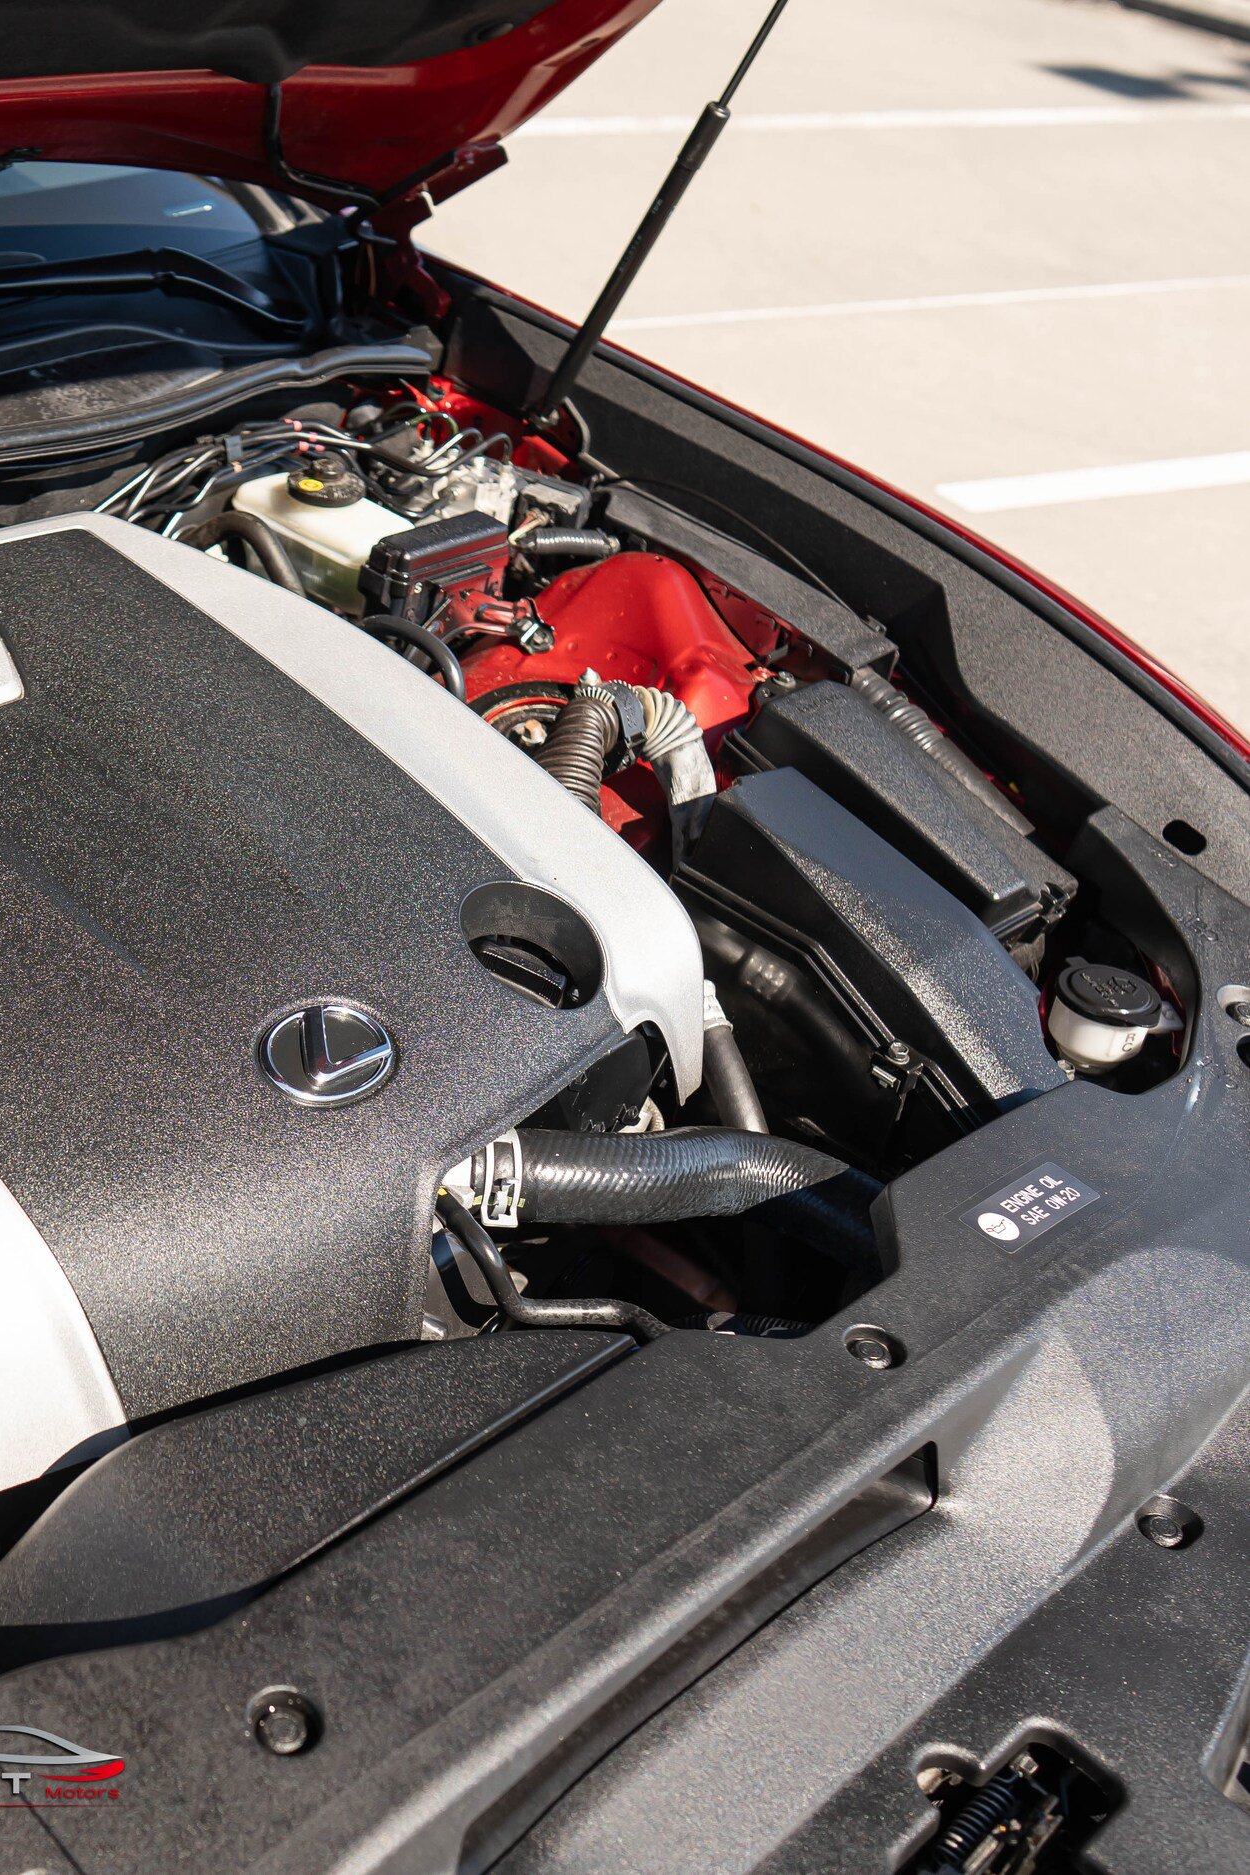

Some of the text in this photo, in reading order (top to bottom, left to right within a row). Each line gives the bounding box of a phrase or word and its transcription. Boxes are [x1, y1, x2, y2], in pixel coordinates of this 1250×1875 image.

[413, 582, 424, 594] S
[999, 1175, 1064, 1213] ENGINE OIL
[1020, 1186, 1081, 1226] SAE 0W-20
